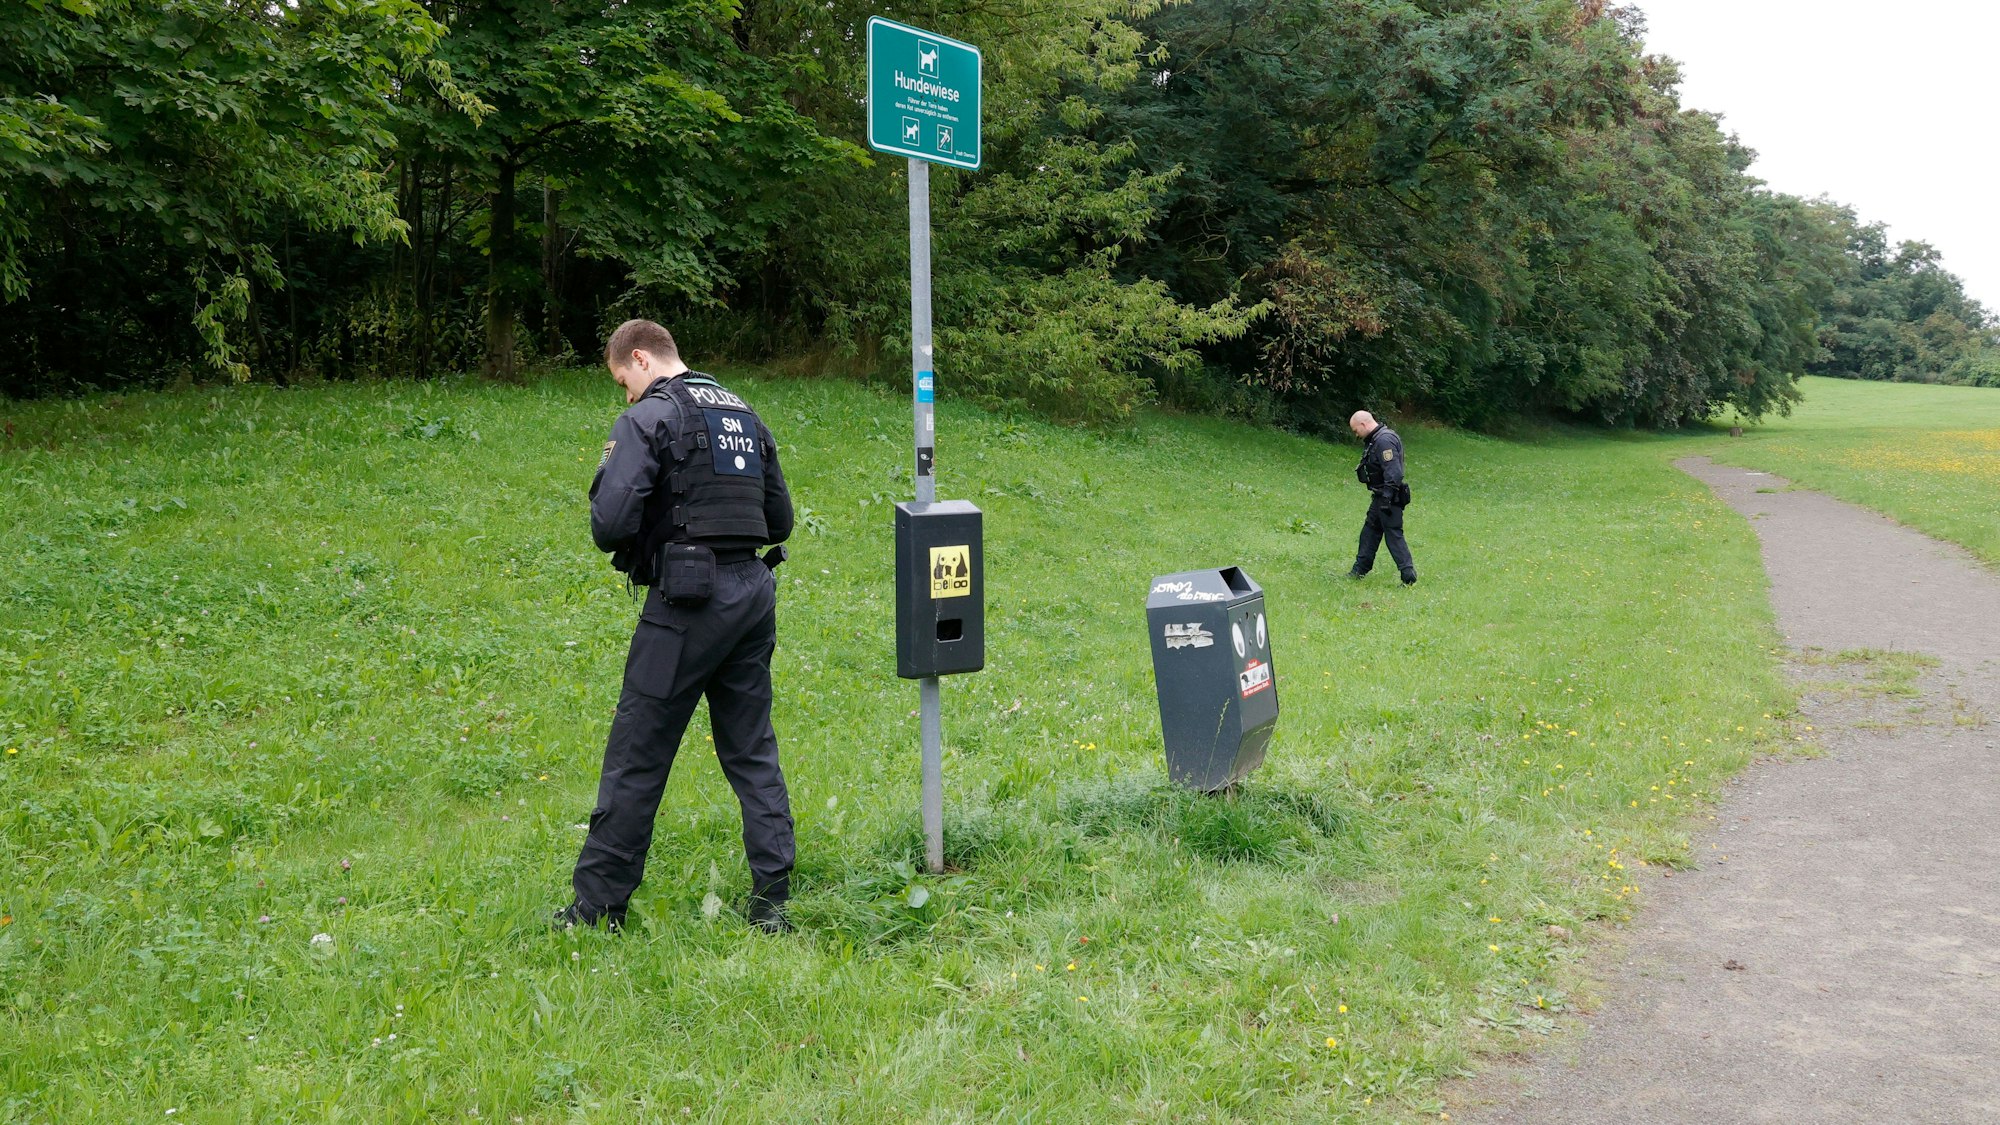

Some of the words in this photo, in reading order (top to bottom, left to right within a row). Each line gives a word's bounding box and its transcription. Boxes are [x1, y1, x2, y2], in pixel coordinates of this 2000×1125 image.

[895, 70, 959, 102] Hundewiese
[688, 388, 747, 409] POLIZEI
[721, 417, 743, 433] SN
[718, 435, 754, 453] 31/12
